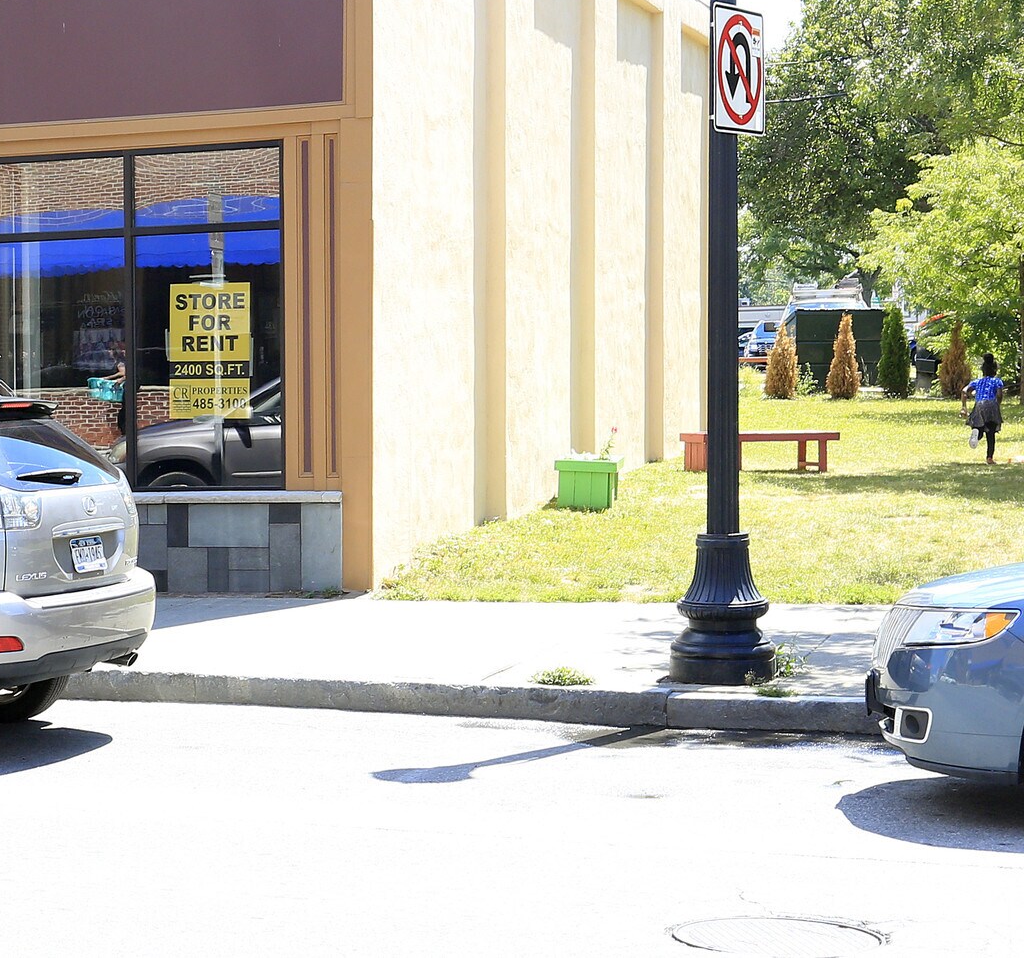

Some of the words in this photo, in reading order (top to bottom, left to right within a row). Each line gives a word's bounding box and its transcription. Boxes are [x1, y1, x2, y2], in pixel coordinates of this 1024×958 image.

[175, 293, 245, 310] STORE
[189, 314, 231, 331] FOR
[182, 335, 238, 352] RENT
[174, 364, 202, 376] 2400
[205, 364, 245, 376] SQ.FT.
[173, 387, 189, 399] CR
[192, 386, 248, 395] PROPERTIES
[15, 571, 48, 582] LEXUS
